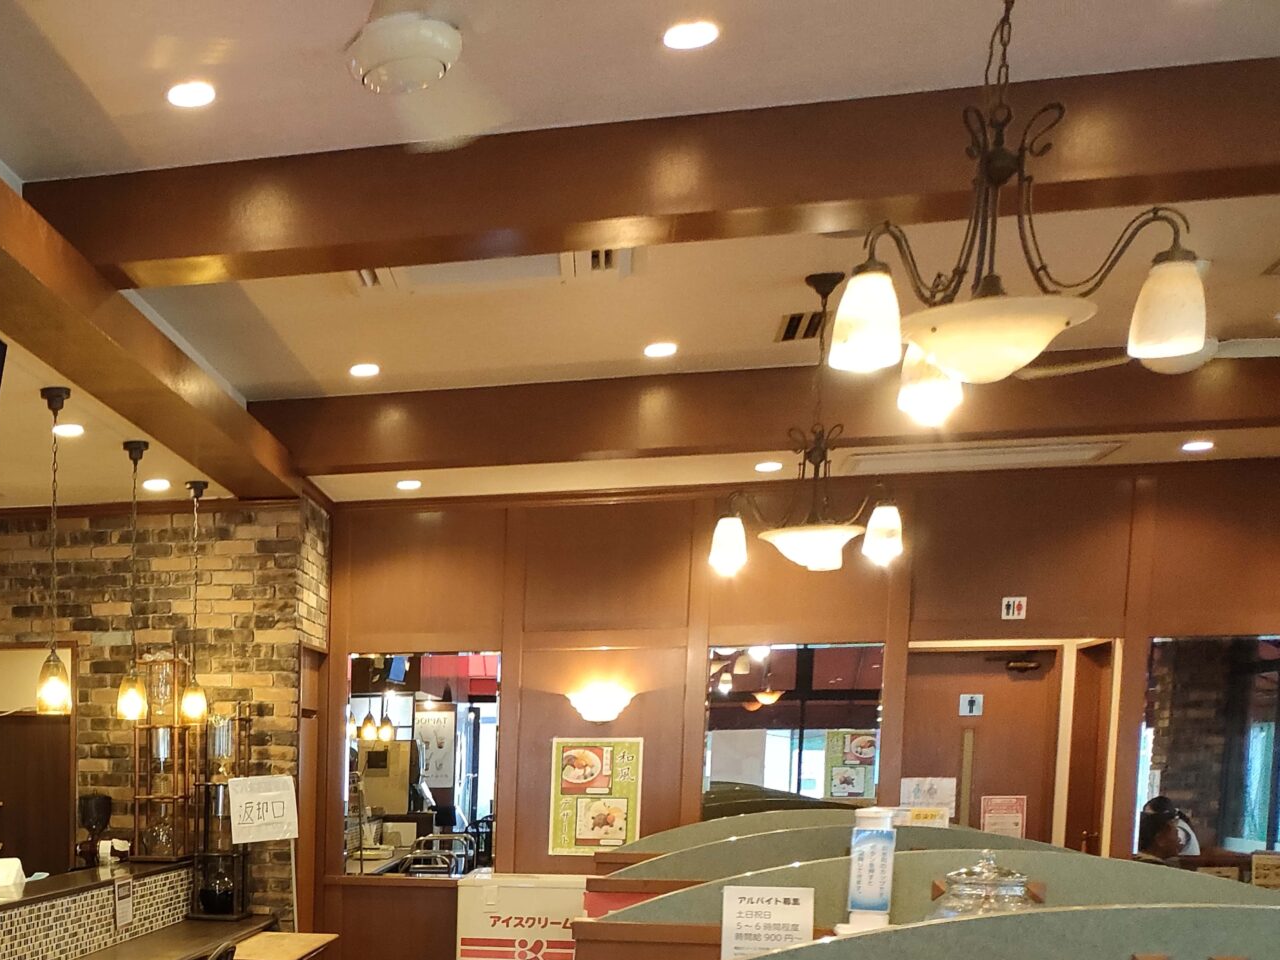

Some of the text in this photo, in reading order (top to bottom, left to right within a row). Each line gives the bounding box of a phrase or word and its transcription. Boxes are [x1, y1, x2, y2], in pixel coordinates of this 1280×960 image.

[237, 801, 285, 825] 返却口
[738, 896, 801, 906] アルバイト募集
[736, 910, 771, 919] 土日祝日
[489, 915, 573, 929] アイスクリーム
